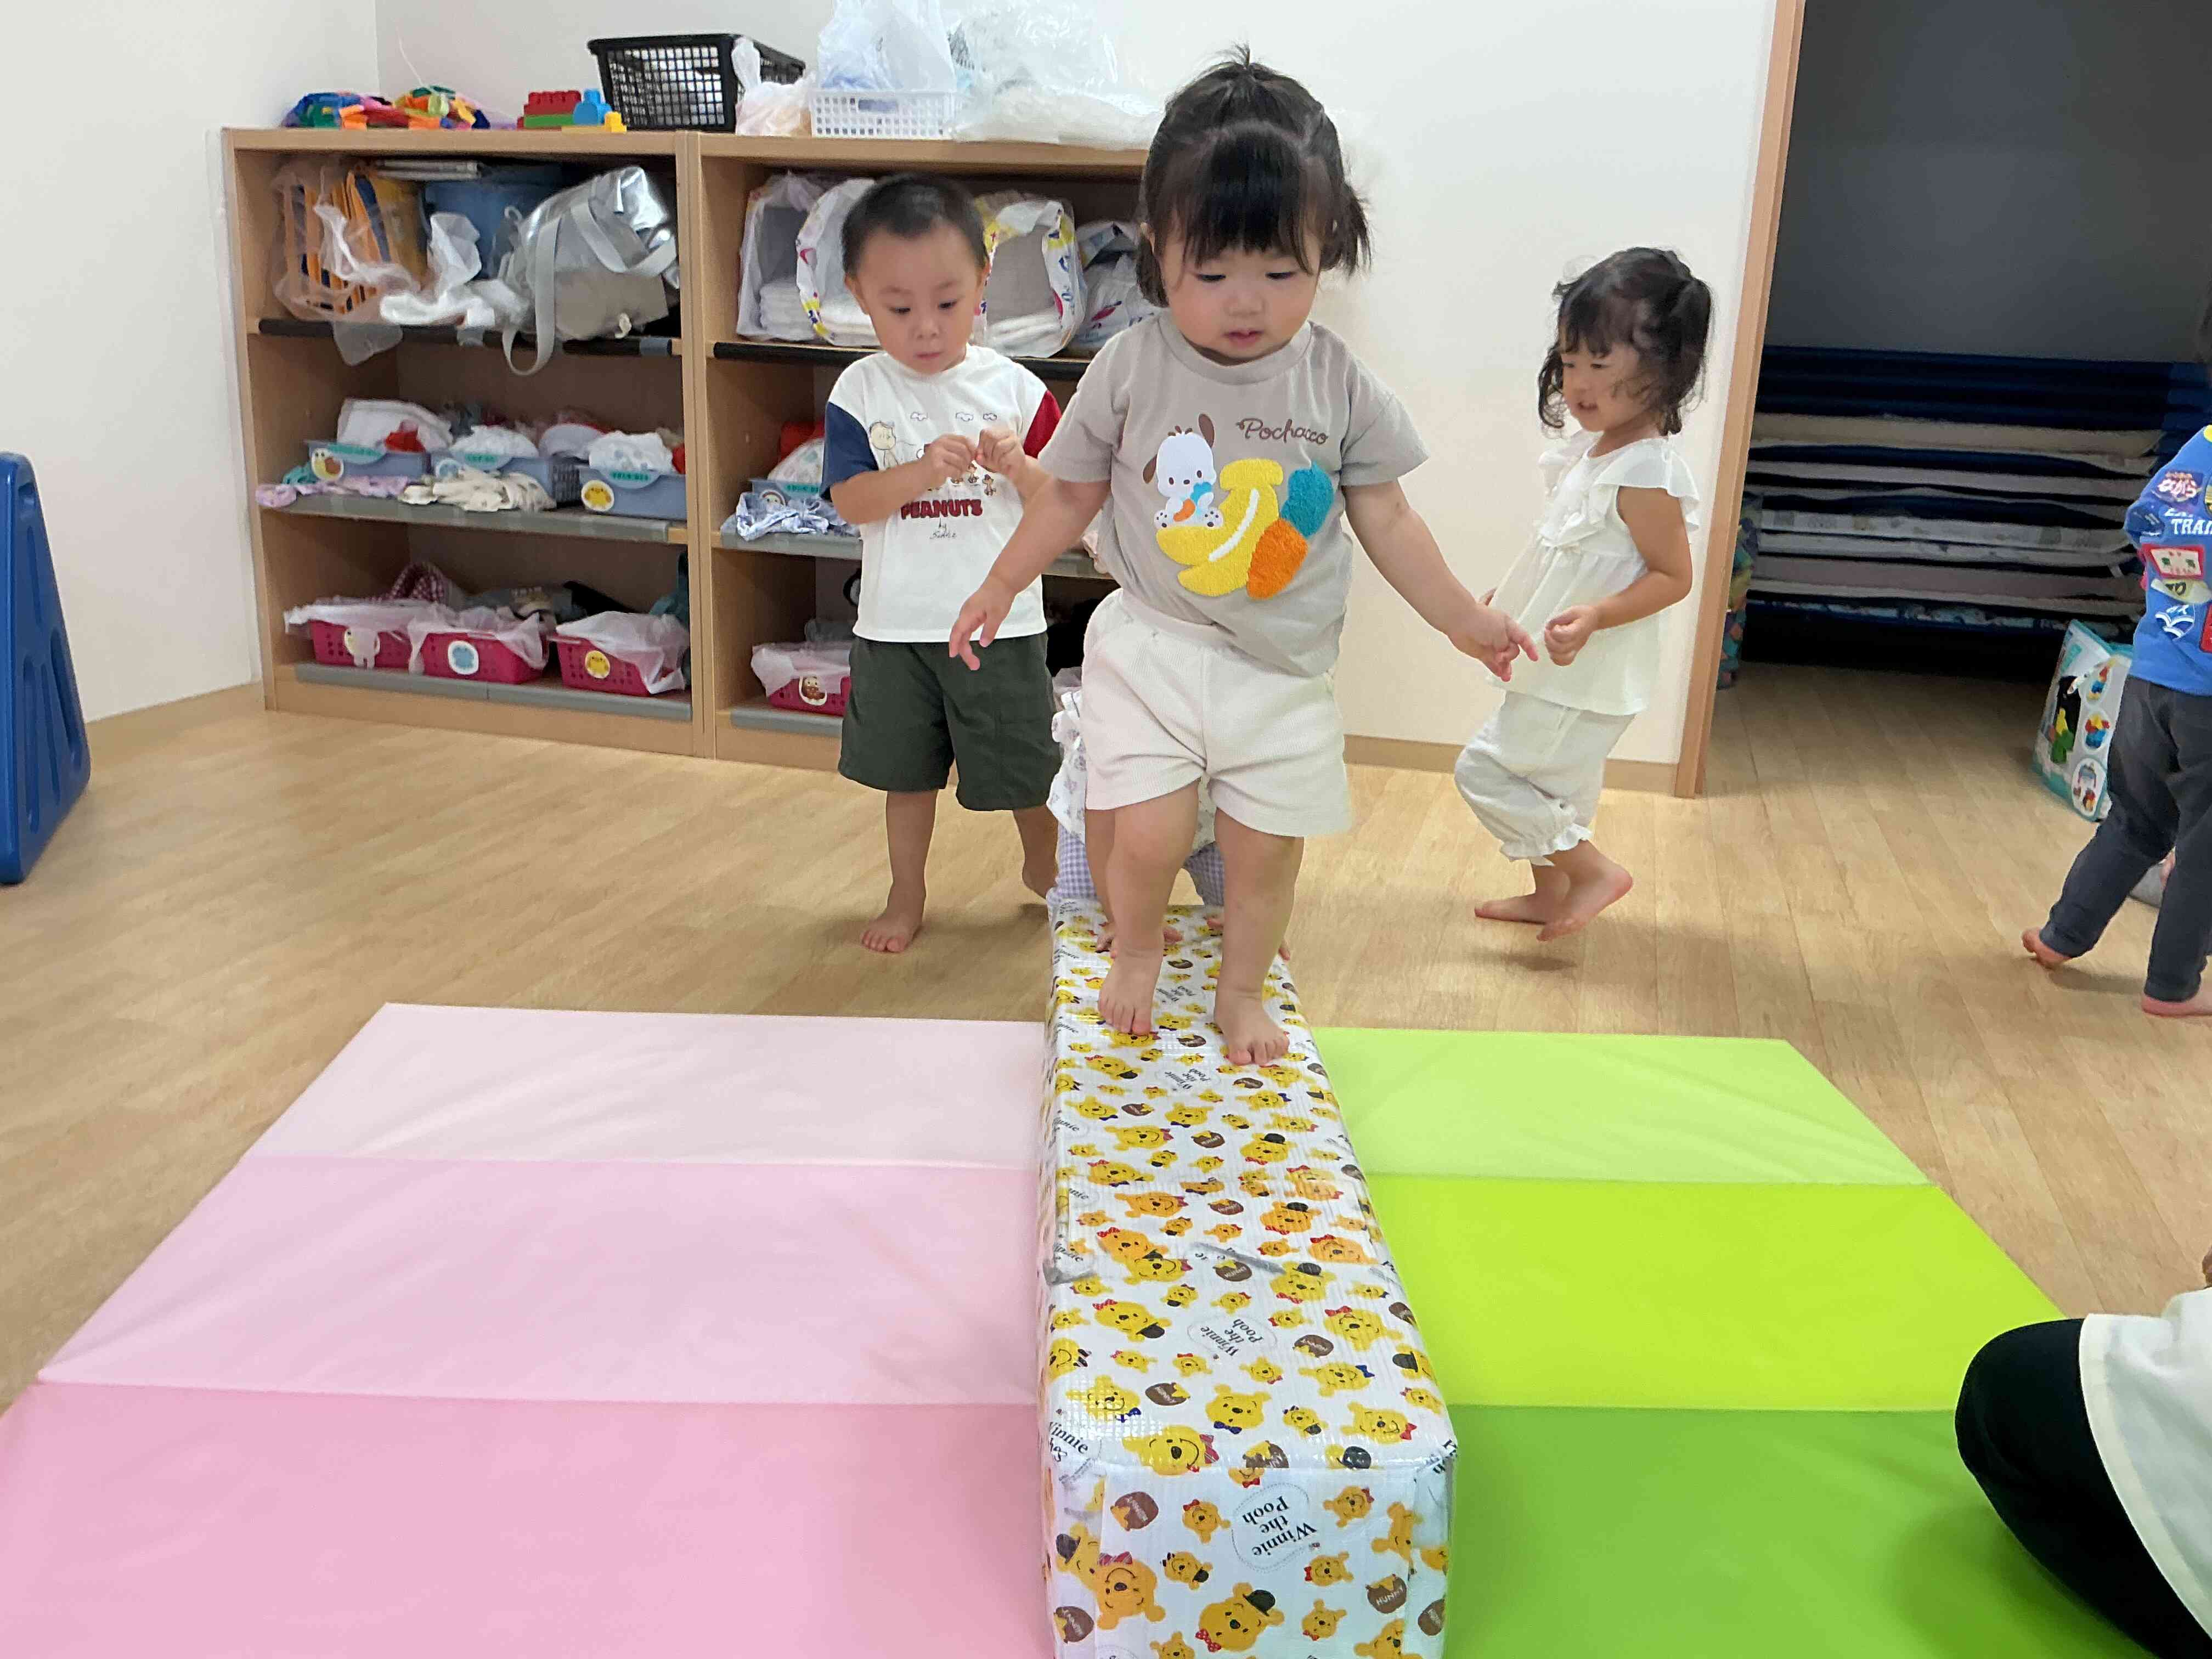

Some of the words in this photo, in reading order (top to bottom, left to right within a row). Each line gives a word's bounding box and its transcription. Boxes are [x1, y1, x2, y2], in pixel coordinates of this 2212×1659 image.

[1235, 417, 1328, 444] Pochacco
[900, 499, 983, 520] PEANUTS
[2171, 518, 2212, 534] TRAI
[1200, 1326, 1239, 1356] Winnie
[1224, 1329, 1244, 1343] the
[1232, 1318, 1264, 1343] Pooh
[1242, 1496, 1290, 1525] Pooh
[1259, 1515, 1289, 1533] the
[1251, 1522, 1317, 1556] Winnie
